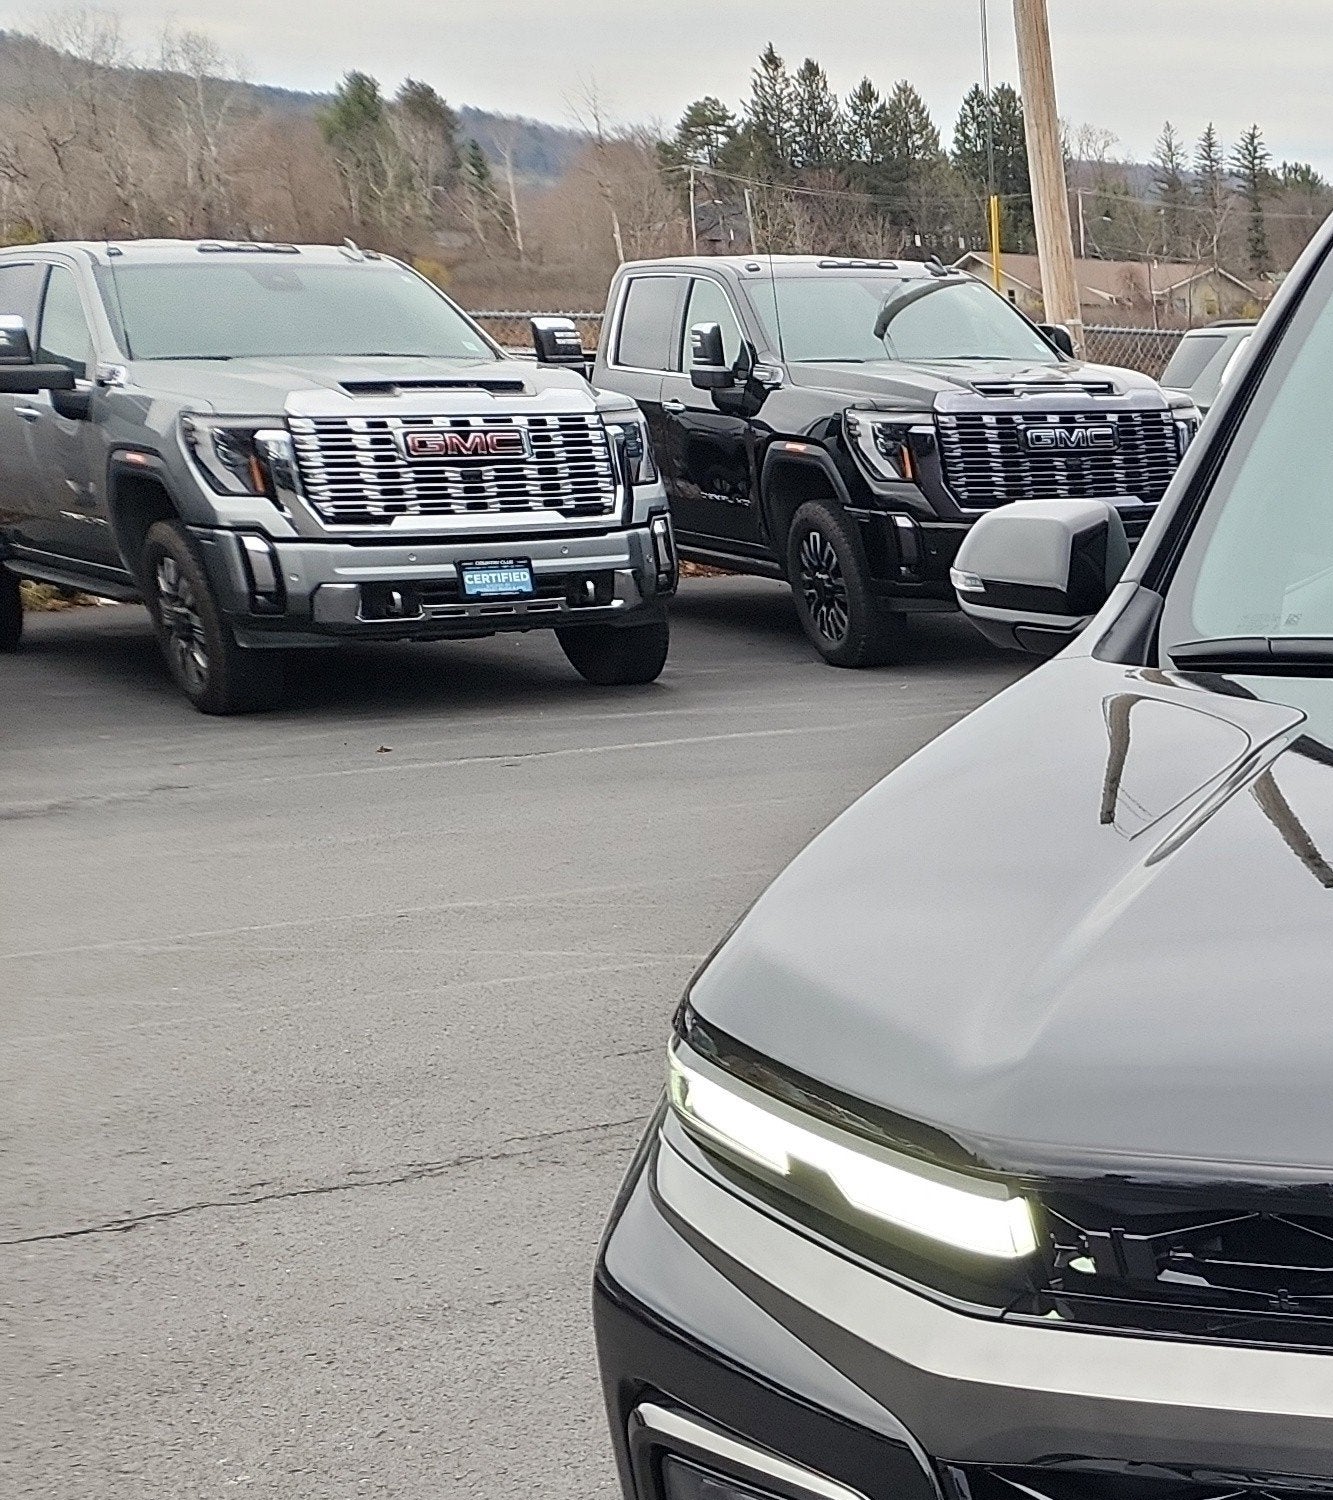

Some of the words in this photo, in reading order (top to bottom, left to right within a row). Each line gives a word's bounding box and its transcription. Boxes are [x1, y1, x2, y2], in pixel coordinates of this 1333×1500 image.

[406, 432, 523, 456] GMC
[1026, 428, 1114, 448] GMC
[464, 571, 530, 585] CERTIFIED
